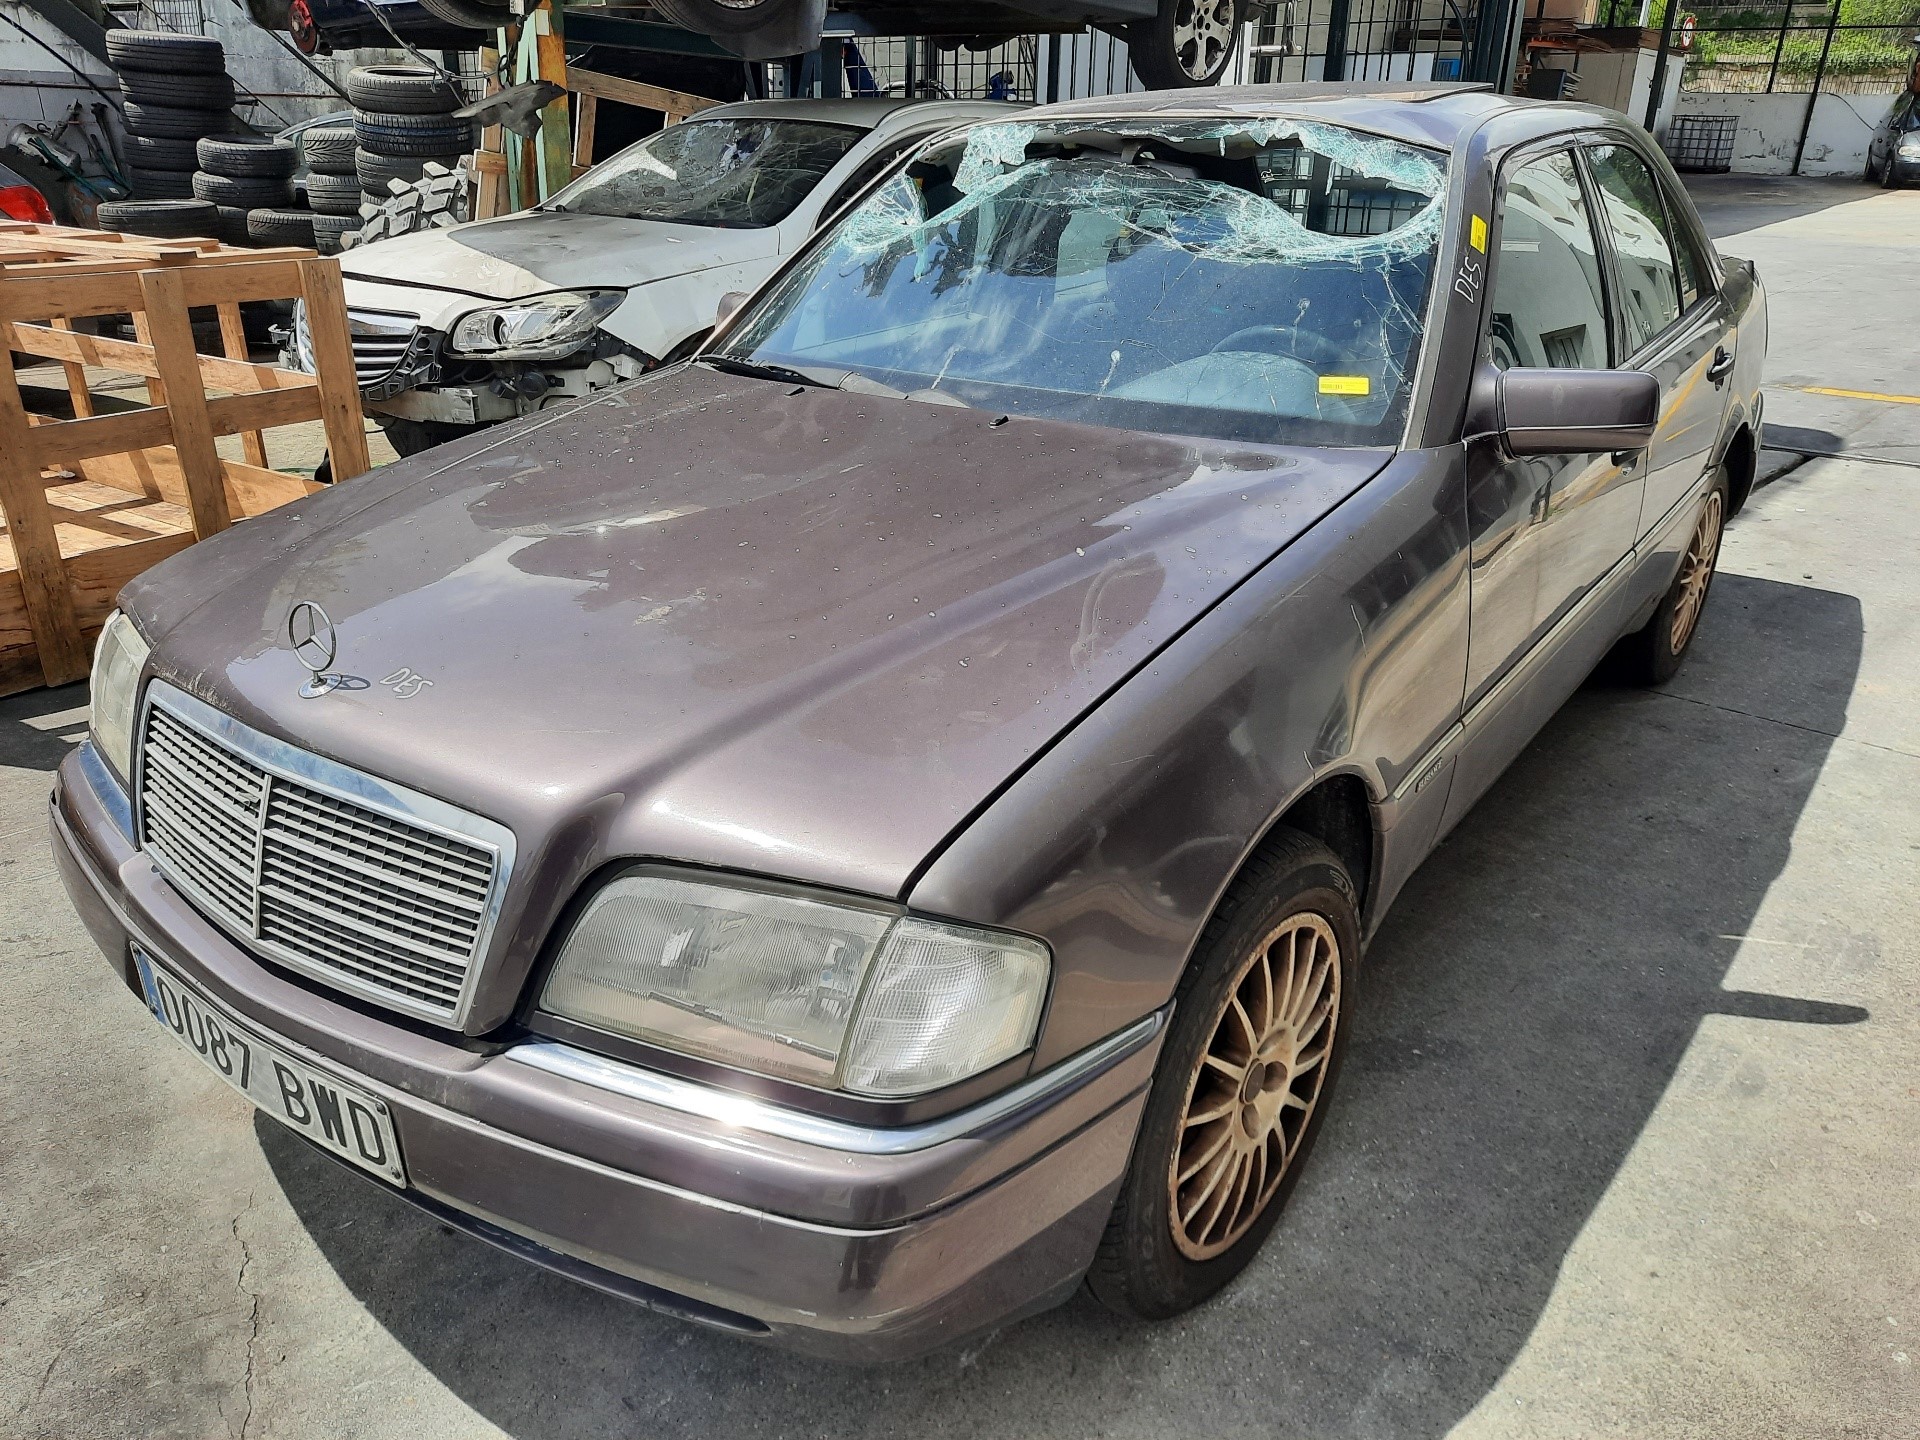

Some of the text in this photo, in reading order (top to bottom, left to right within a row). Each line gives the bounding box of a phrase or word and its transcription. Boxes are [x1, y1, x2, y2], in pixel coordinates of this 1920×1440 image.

[1454, 256, 1482, 304] DES
[379, 667, 434, 699] DES
[156, 975, 387, 1166] 0087 BWD
